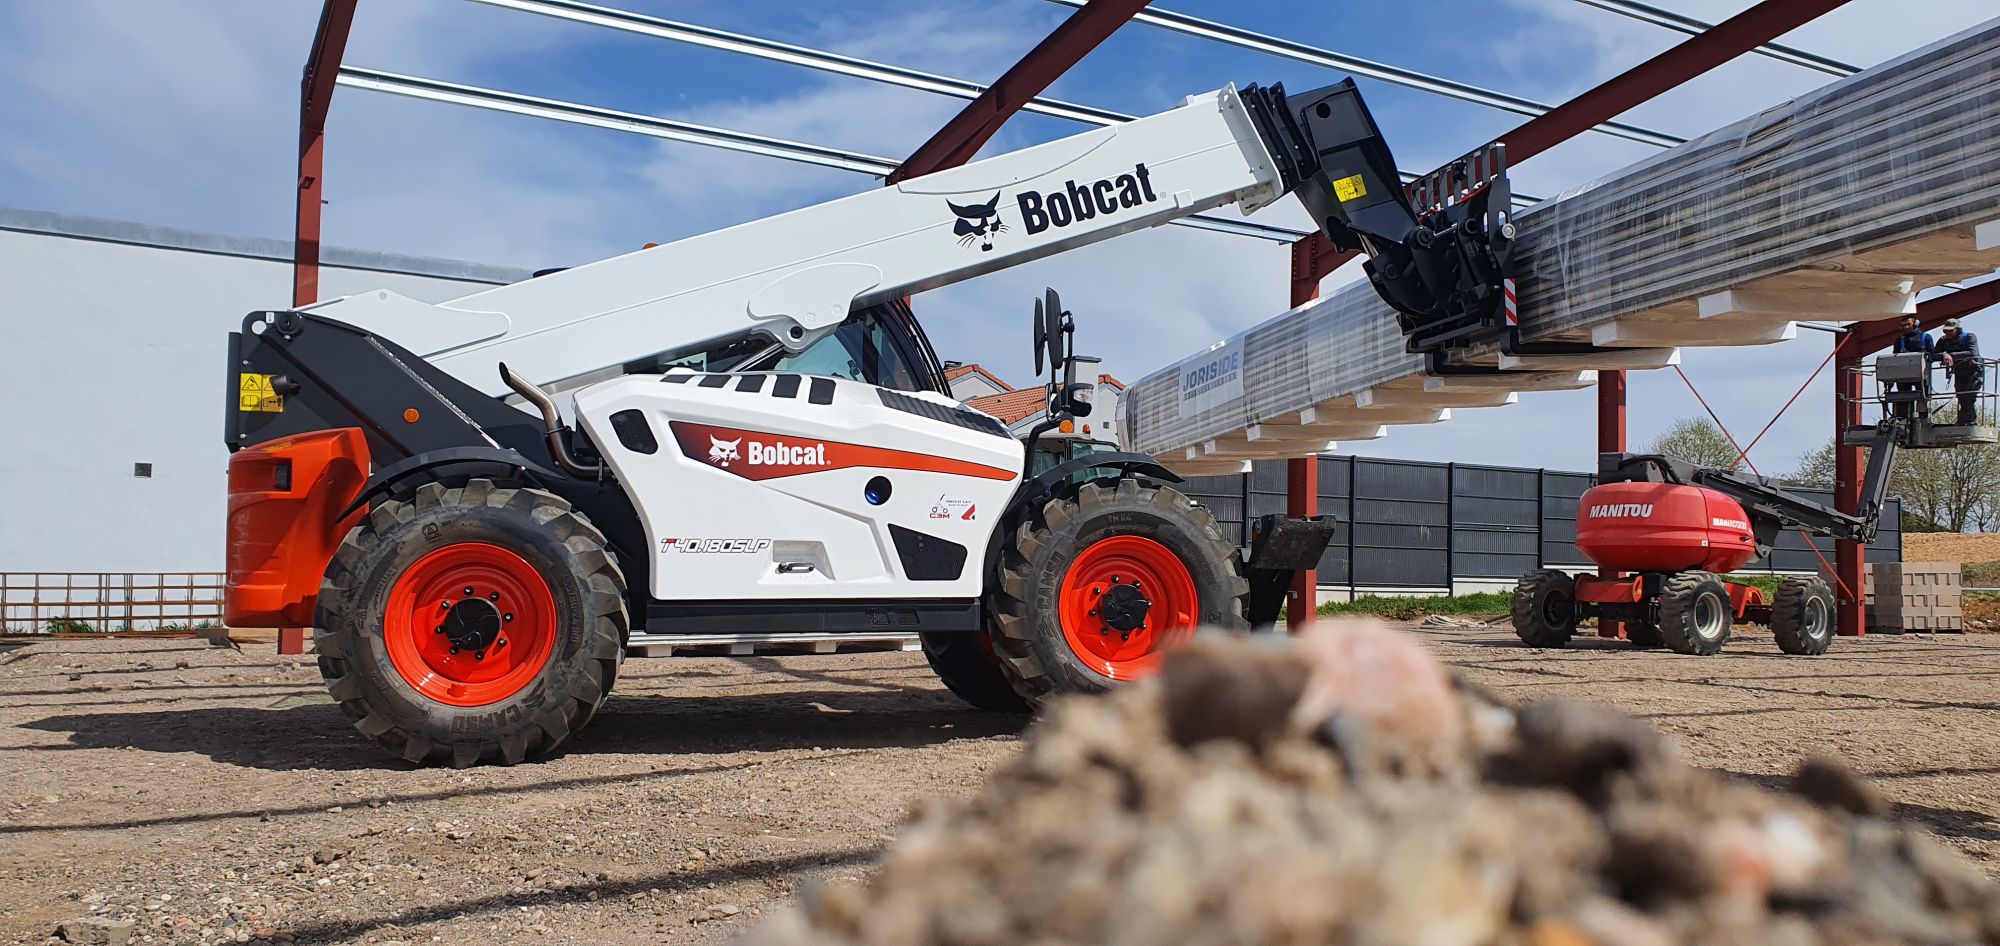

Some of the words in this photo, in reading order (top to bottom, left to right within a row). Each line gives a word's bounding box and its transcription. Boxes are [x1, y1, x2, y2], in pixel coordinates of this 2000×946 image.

[1016, 162, 1157, 236] Bobcat
[1182, 351, 1239, 392] JORISIDE
[748, 441, 825, 466] Bobcat
[1589, 503, 1653, 519] MANITOU
